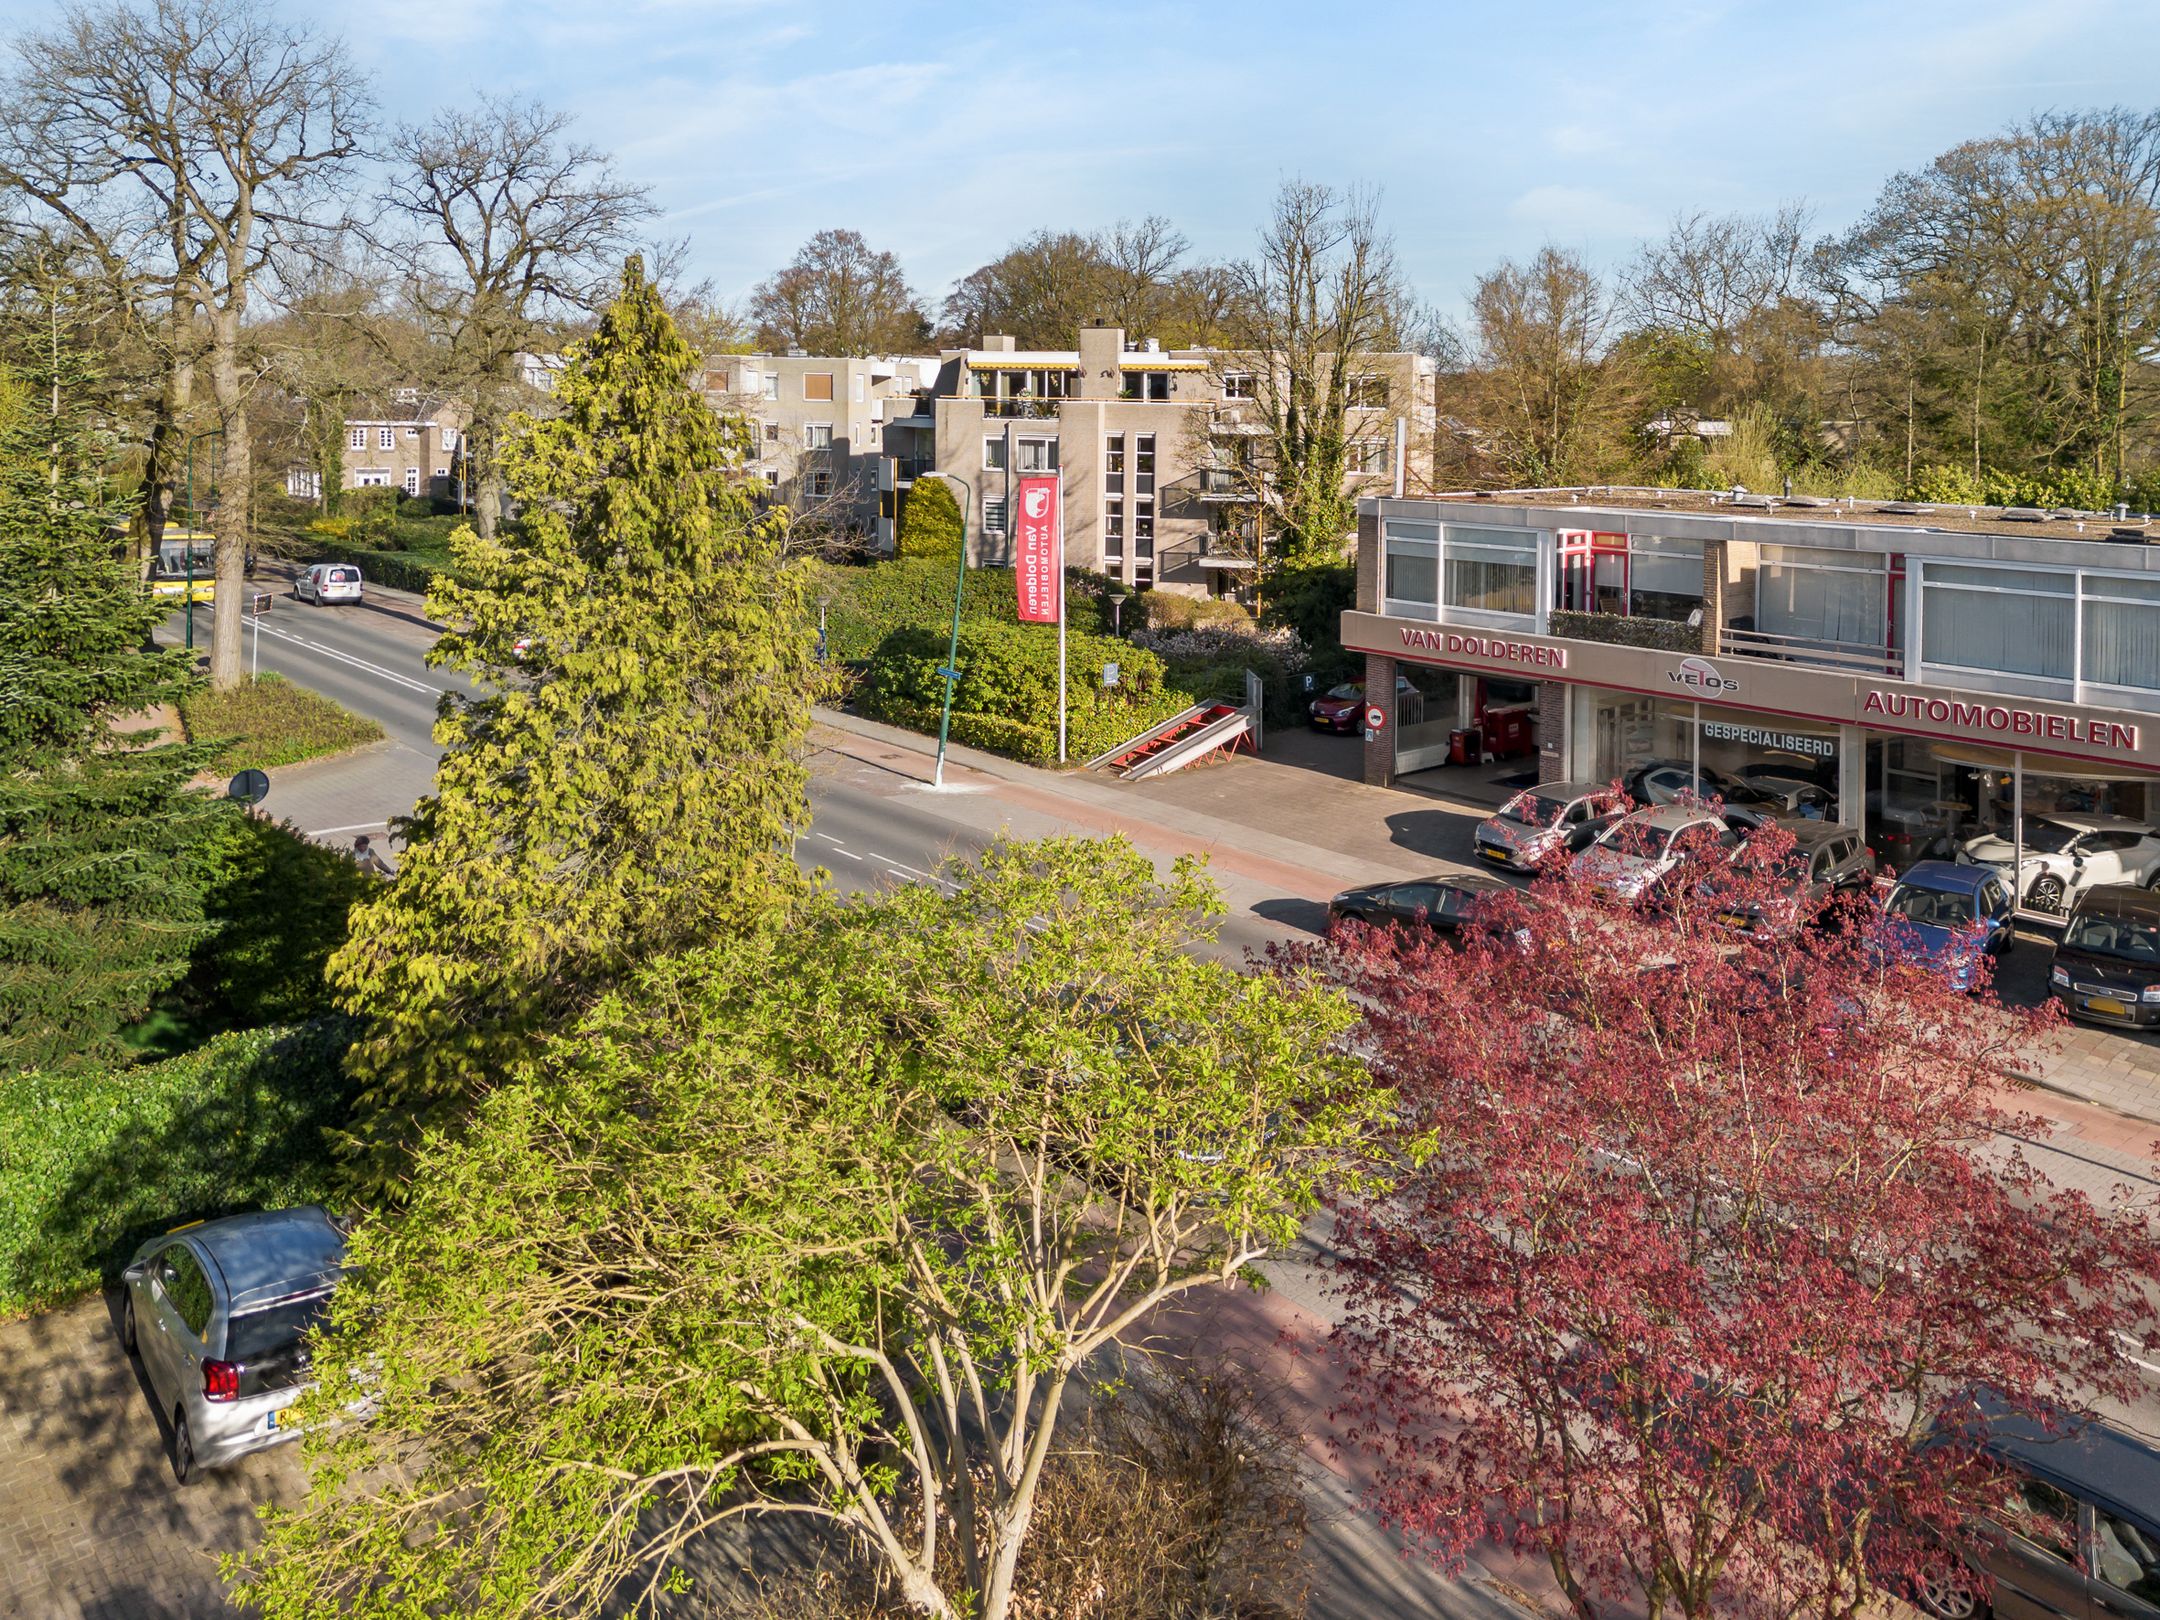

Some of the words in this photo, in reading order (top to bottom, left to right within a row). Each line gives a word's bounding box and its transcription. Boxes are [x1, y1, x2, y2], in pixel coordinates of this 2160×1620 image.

[1400, 628, 1443, 651] VAN
[1448, 634, 1568, 669] DOLDEREN
[1704, 723, 1834, 757] GESPECIALISEERD
[1863, 691, 2139, 752] AUTOMOBIELEN
